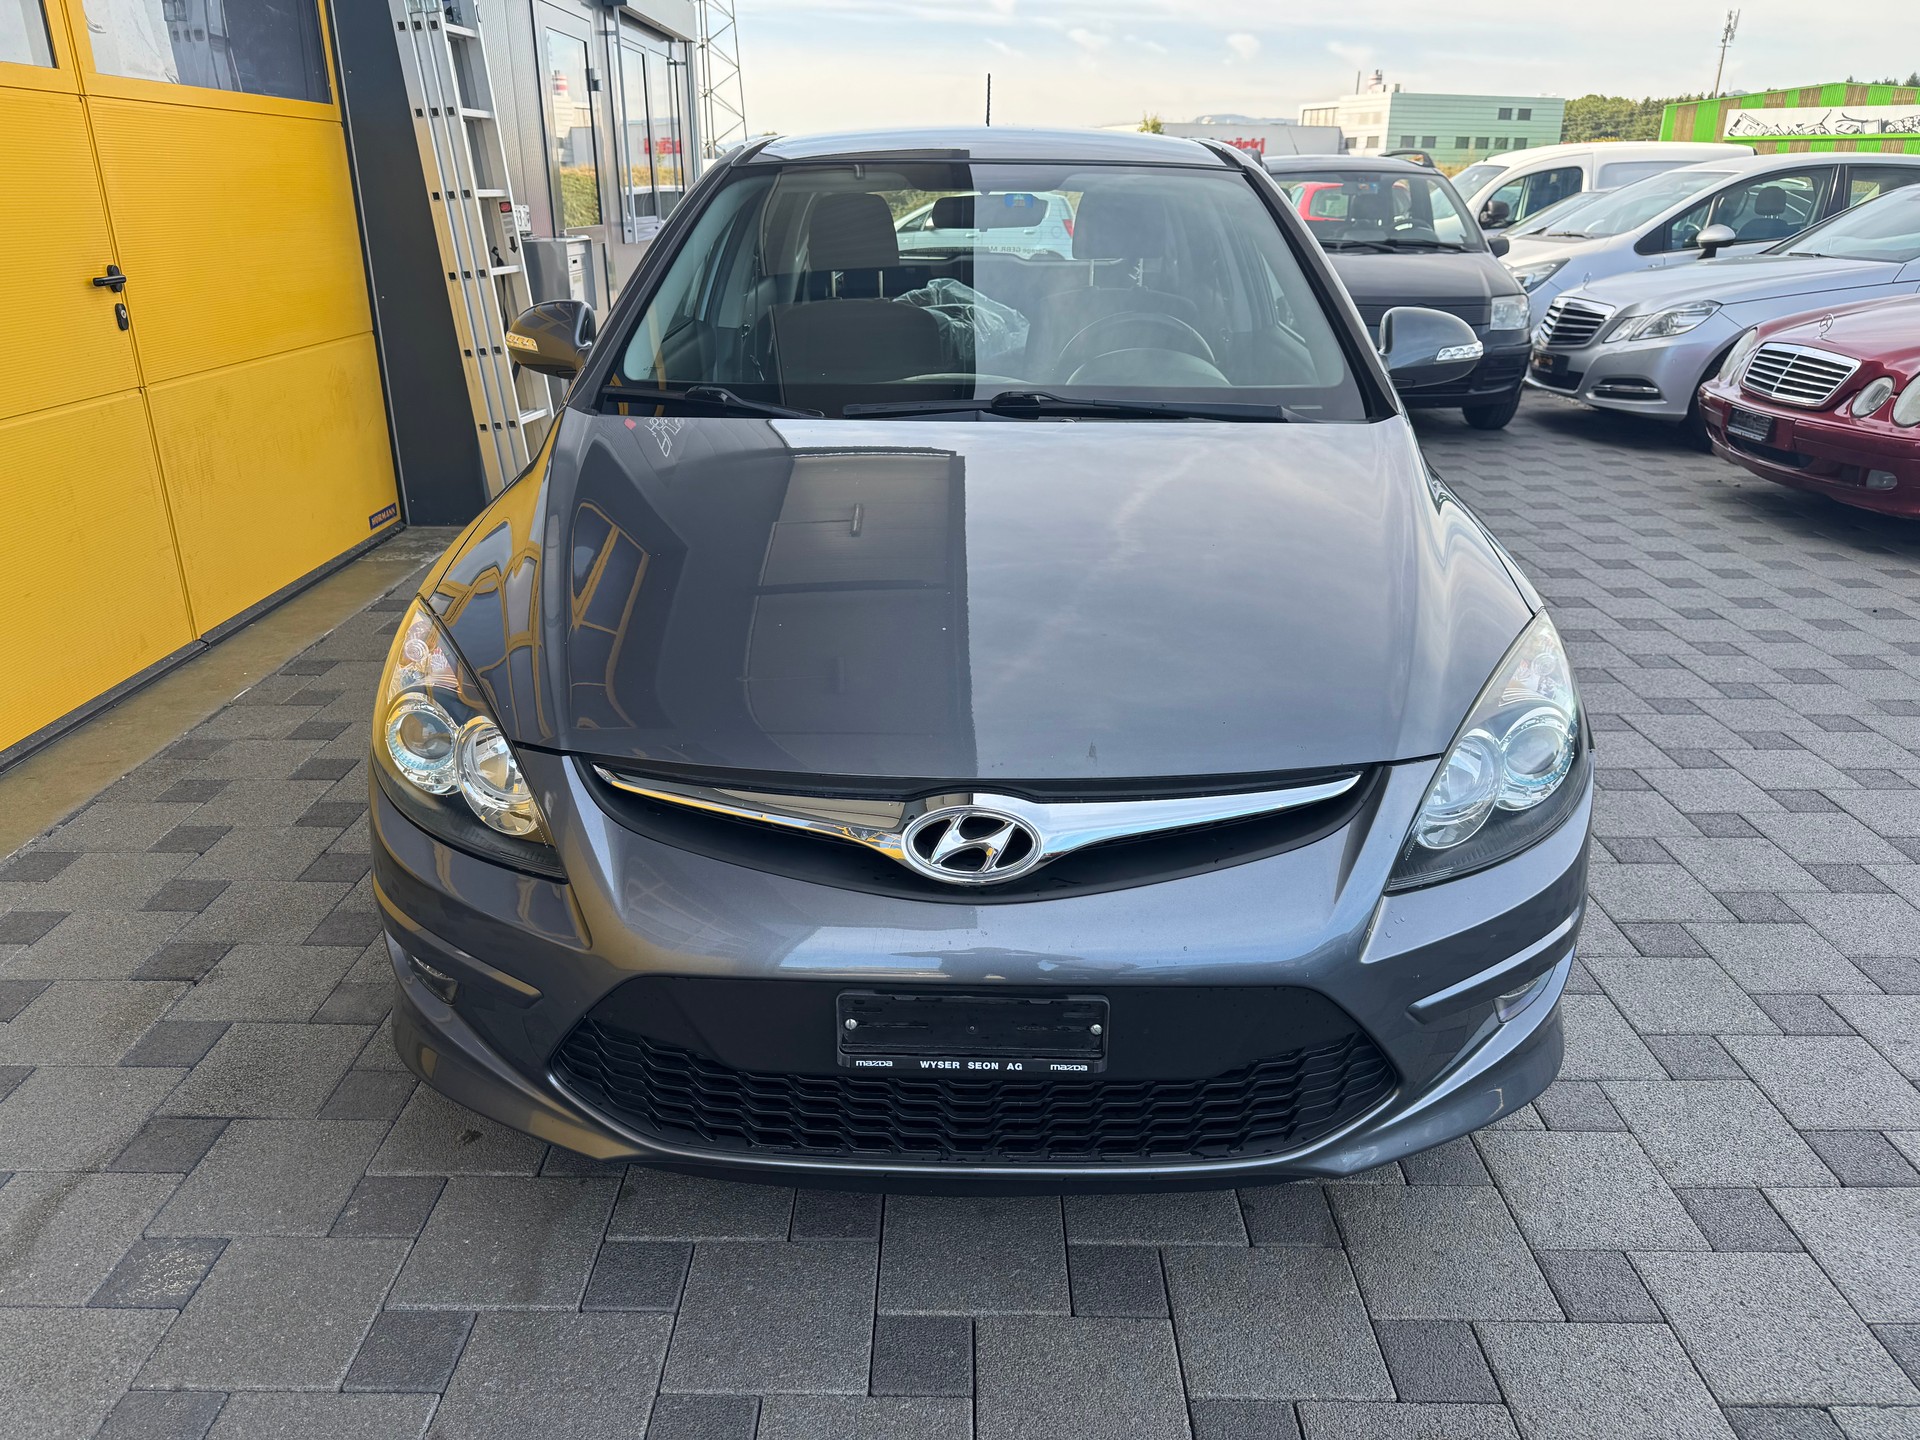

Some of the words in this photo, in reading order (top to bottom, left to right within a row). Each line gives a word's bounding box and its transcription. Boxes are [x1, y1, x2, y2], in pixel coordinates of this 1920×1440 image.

[920, 1060, 960, 1070] WYSER
[967, 1061, 999, 1070] SEON
[1006, 1062, 1023, 1071] AG
